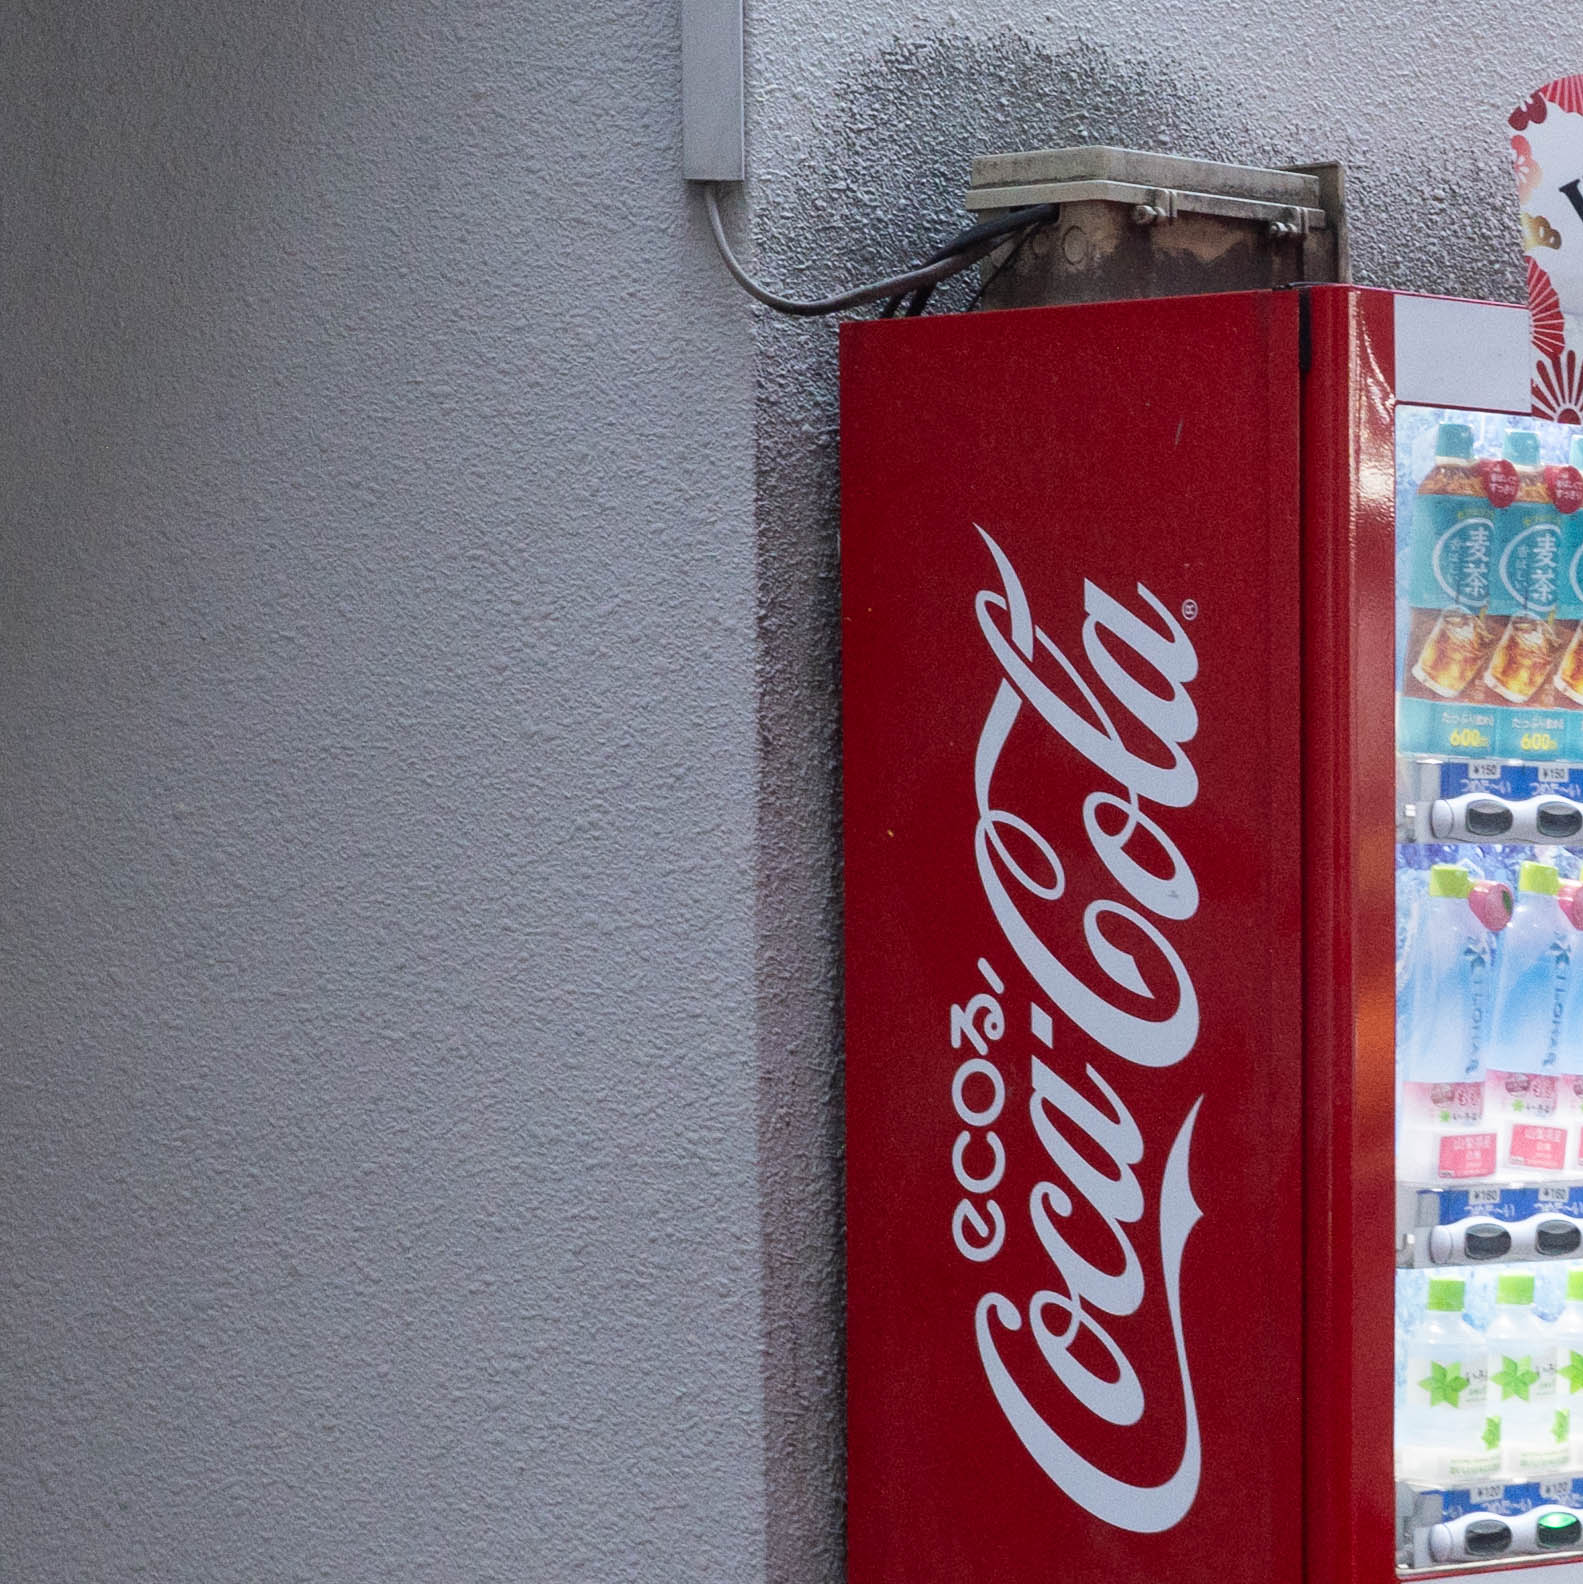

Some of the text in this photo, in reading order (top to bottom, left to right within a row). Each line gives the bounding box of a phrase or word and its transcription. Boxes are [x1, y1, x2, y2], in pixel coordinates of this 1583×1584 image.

[1461, 527, 1491, 597] 麦茶
[1529, 534, 1558, 604] 麦茶
[972, 522, 1204, 1535] Coca-Cola
